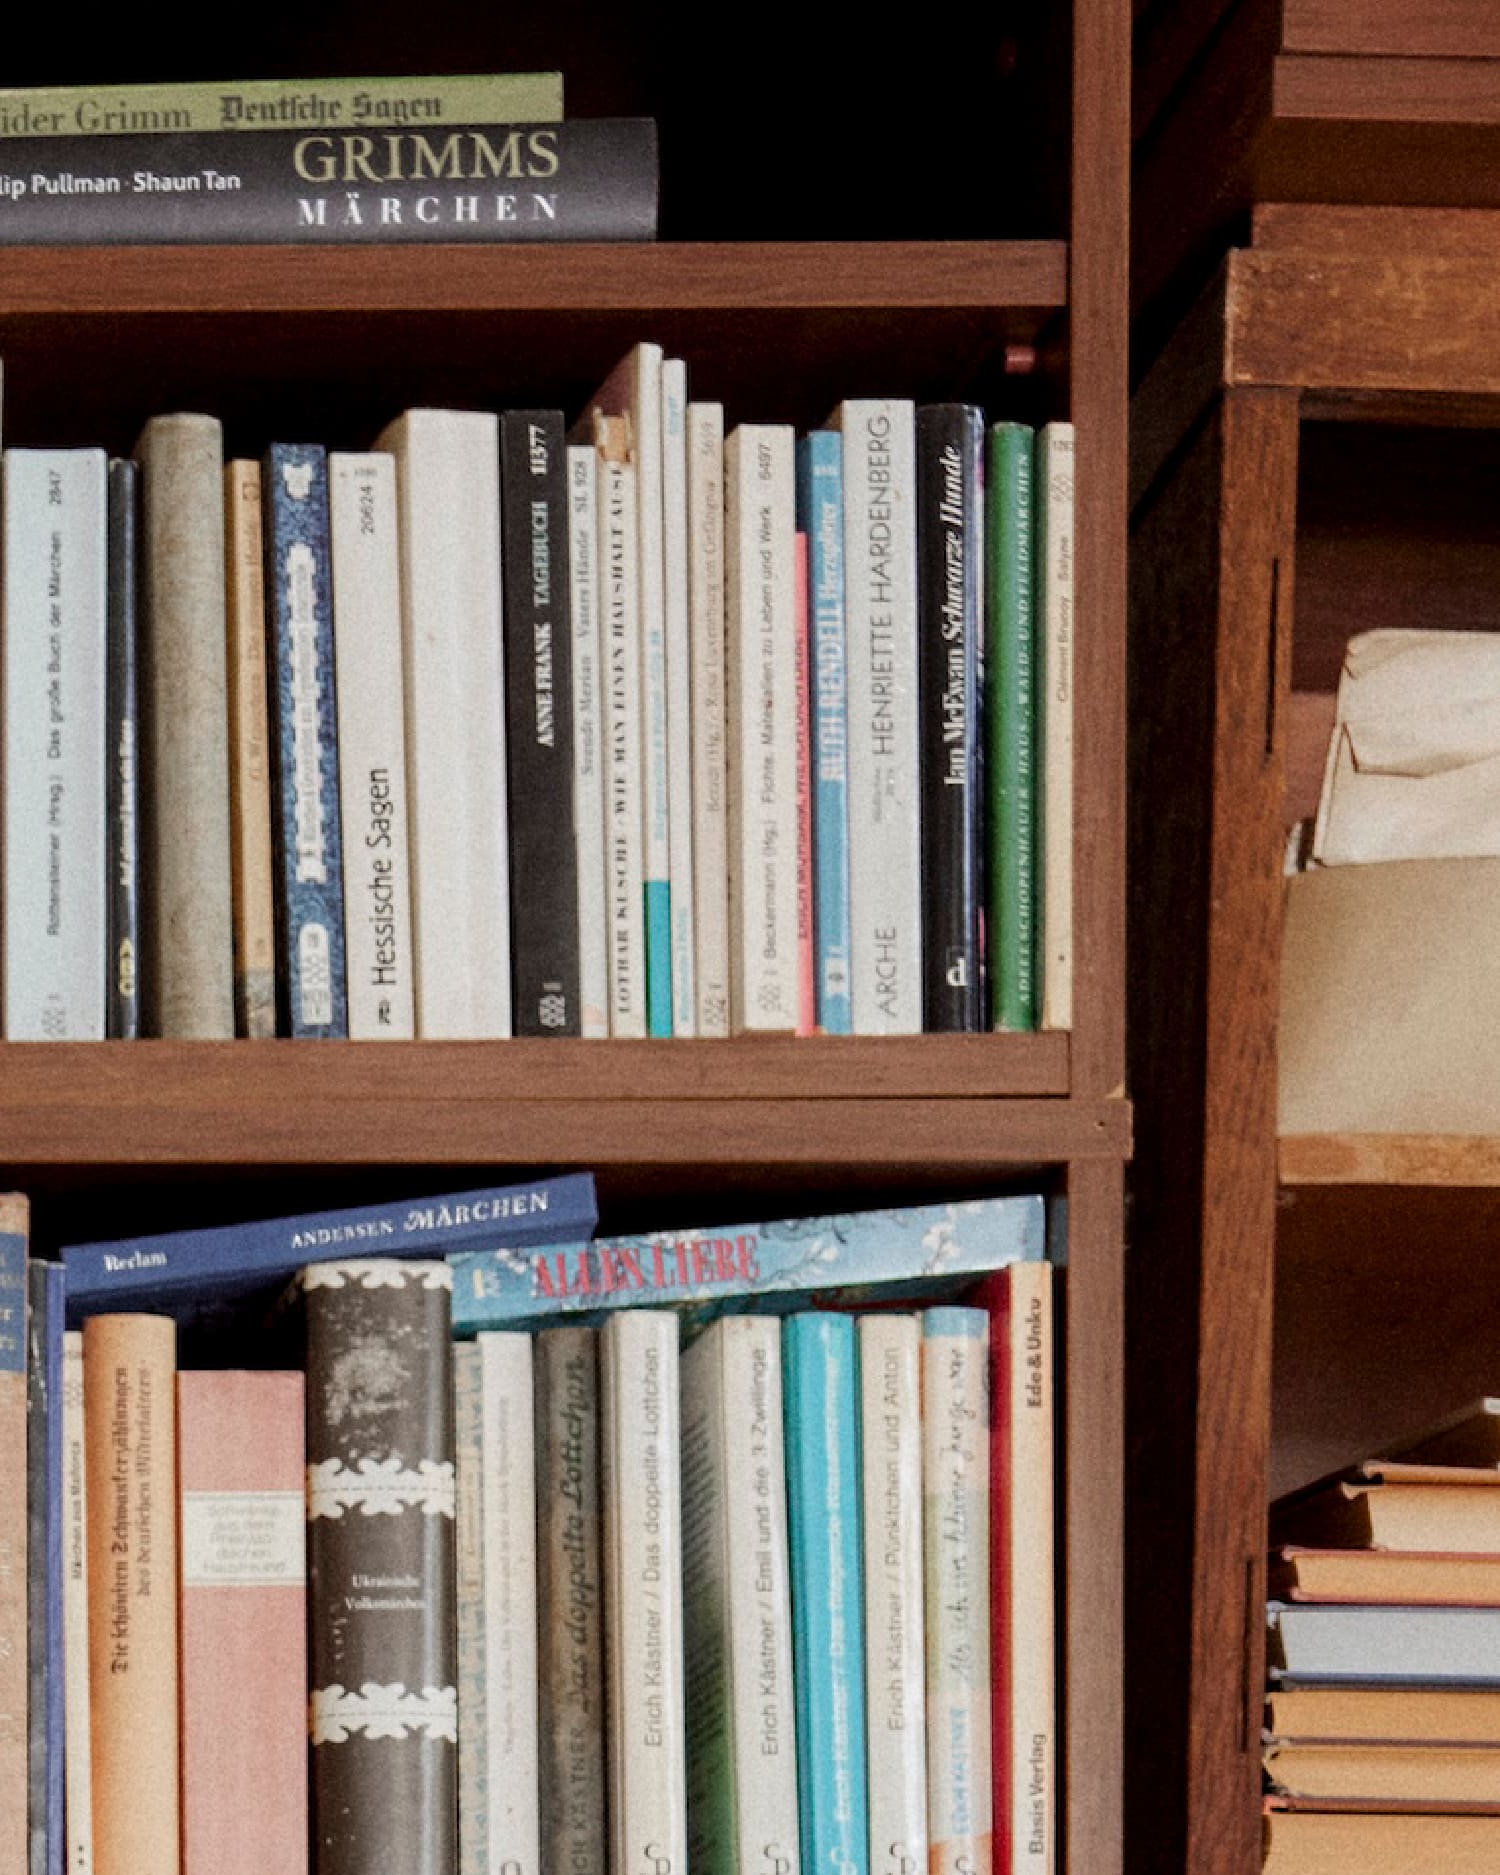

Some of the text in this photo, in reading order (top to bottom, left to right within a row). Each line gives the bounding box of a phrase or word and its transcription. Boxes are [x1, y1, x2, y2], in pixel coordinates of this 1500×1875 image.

[75, 100, 192, 133] Grimm
[31, 173, 120, 196] Pullman
[132, 171, 201, 194] Shaun
[203, 171, 241, 193] Tan
[293, 131, 560, 183] GRIMMS
[297, 192, 558, 226] MÄRCHEN
[866, 415, 894, 604] HARDENBERG
[47, 530, 63, 581] Märchen
[47, 584, 63, 613] der
[936, 444, 965, 744] McEwan Schwarze Hunde
[47, 618, 63, 661] Buch
[530, 501, 555, 747] ANNE FRANK TAGEBUCH
[870, 614, 895, 755] HENRIETTE
[46, 726, 62, 758] Das
[365, 767, 398, 987] Hessische Sagen
[874, 927, 898, 1018] ARCHE
[291, 1190, 550, 1249] ANDERSEN MÄRCHEN
[102, 1249, 169, 1273] Reclam
[534, 1234, 760, 1298] ALLES LIEBE
[1024, 1296, 1043, 1409] Ede & Unku
[750, 1347, 772, 1437] Zwillinge
[752, 1467, 770, 1498] die
[640, 1346, 665, 1748] Erich Kästner Das doppelte Lottchen
[754, 1506, 772, 1544] und
[881, 1346, 905, 1731] Erich Kästner Pünktchen und Anton
[755, 1549, 775, 1594] Emil
[757, 1617, 778, 1697] Kästner
[760, 1703, 780, 1756] Erich
[1027, 1733, 1047, 1855] Basis Verlag
